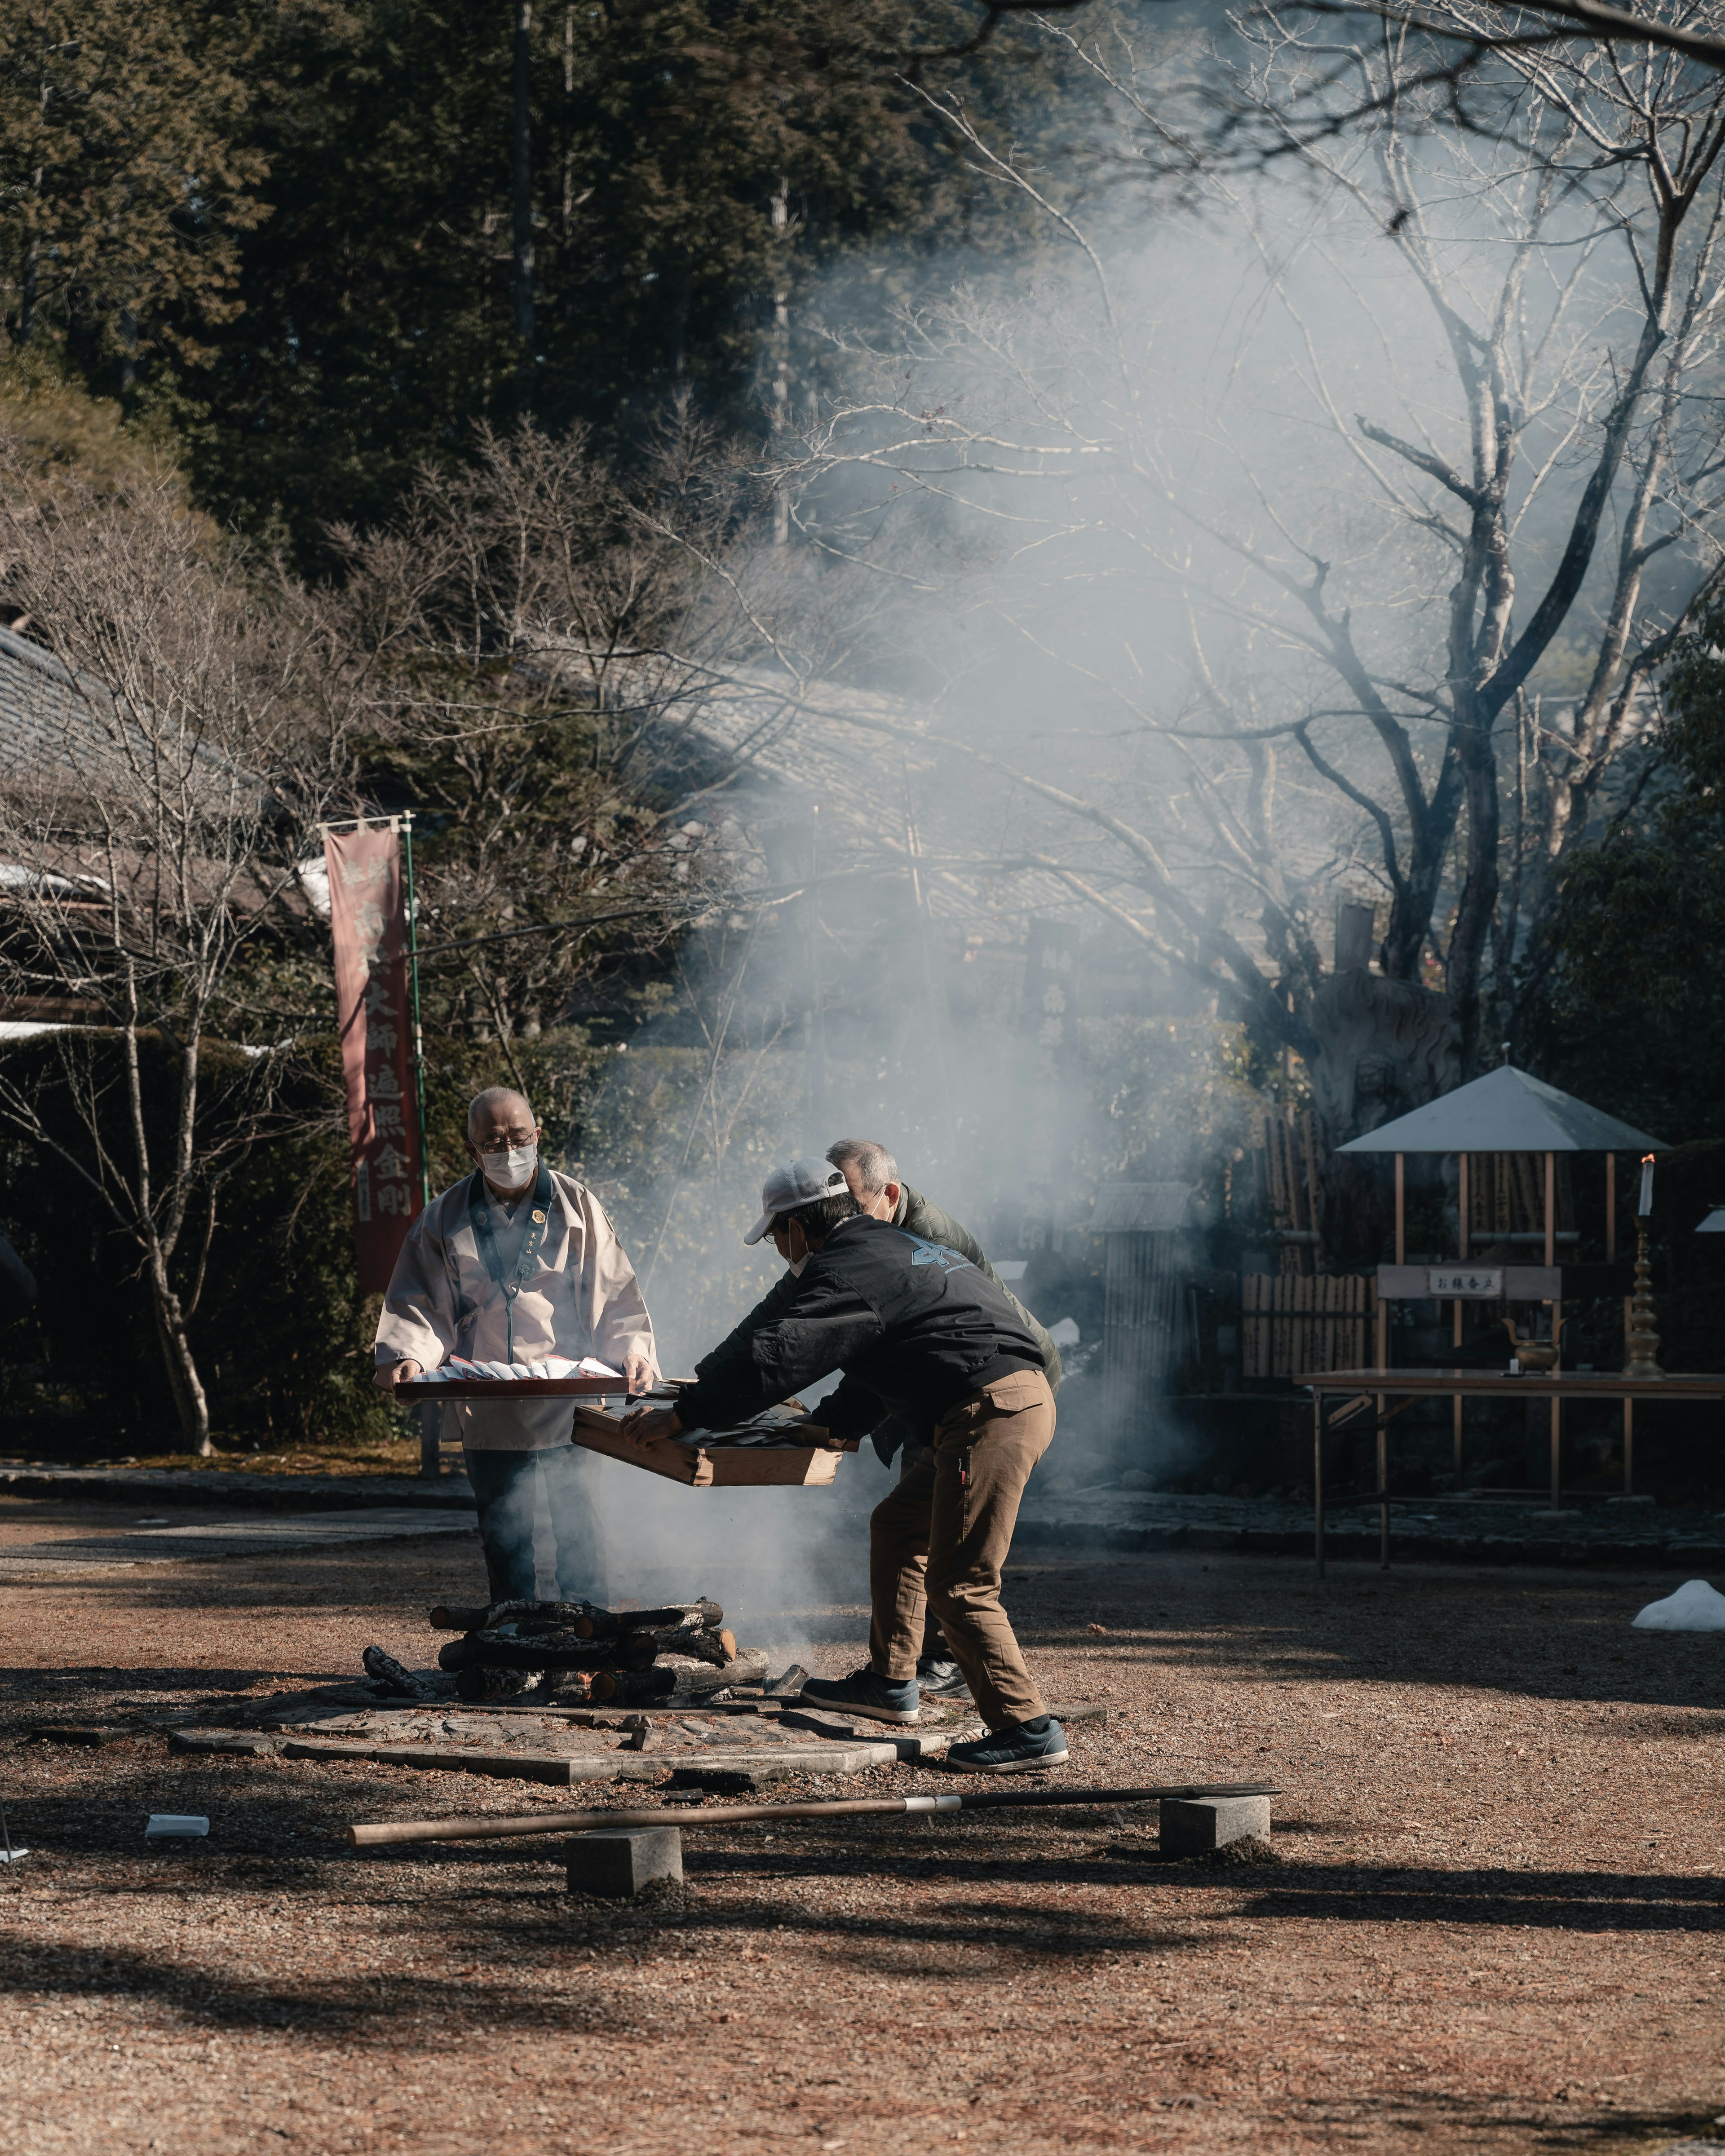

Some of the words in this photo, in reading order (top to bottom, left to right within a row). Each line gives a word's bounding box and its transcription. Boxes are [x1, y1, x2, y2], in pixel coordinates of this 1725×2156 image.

[354, 900, 411, 1216] 南無大師遍照金剛
[526, 1232, 536, 1254] 東方山
